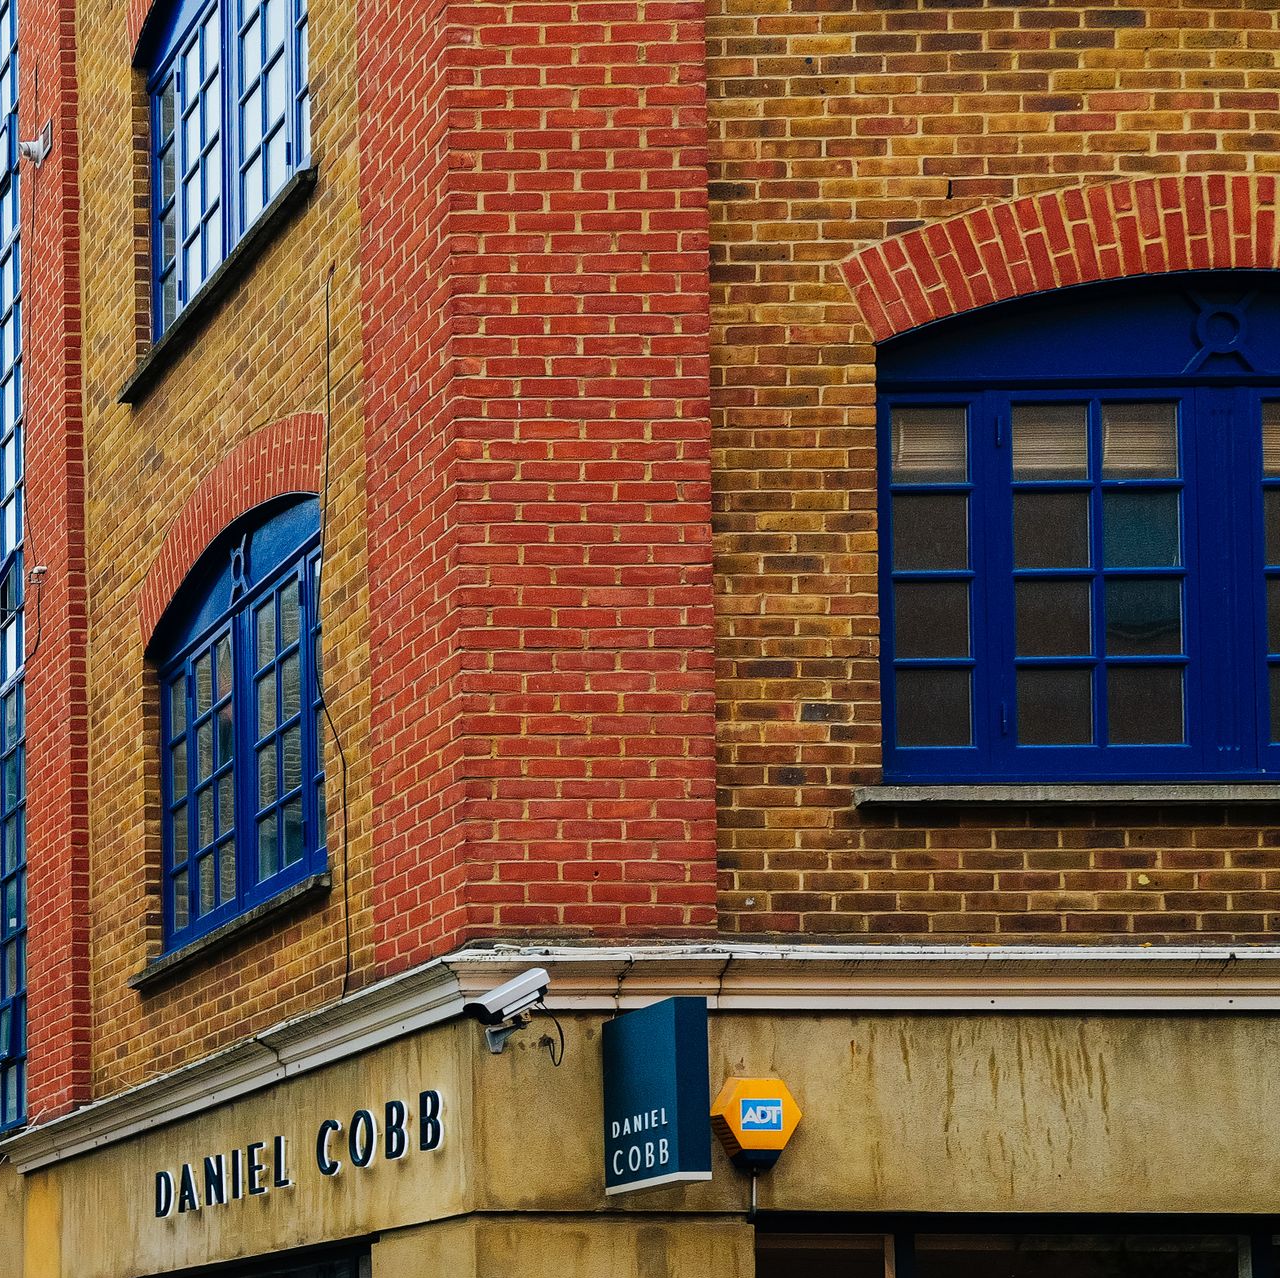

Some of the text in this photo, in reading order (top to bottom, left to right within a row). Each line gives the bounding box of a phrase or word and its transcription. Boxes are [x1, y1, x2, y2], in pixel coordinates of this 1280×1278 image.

[612, 1107, 668, 1139] DANIEL
[742, 1105, 780, 1125] ADT
[155, 1089, 445, 1218] DANIEL COBB
[613, 1138, 669, 1176] COBB
